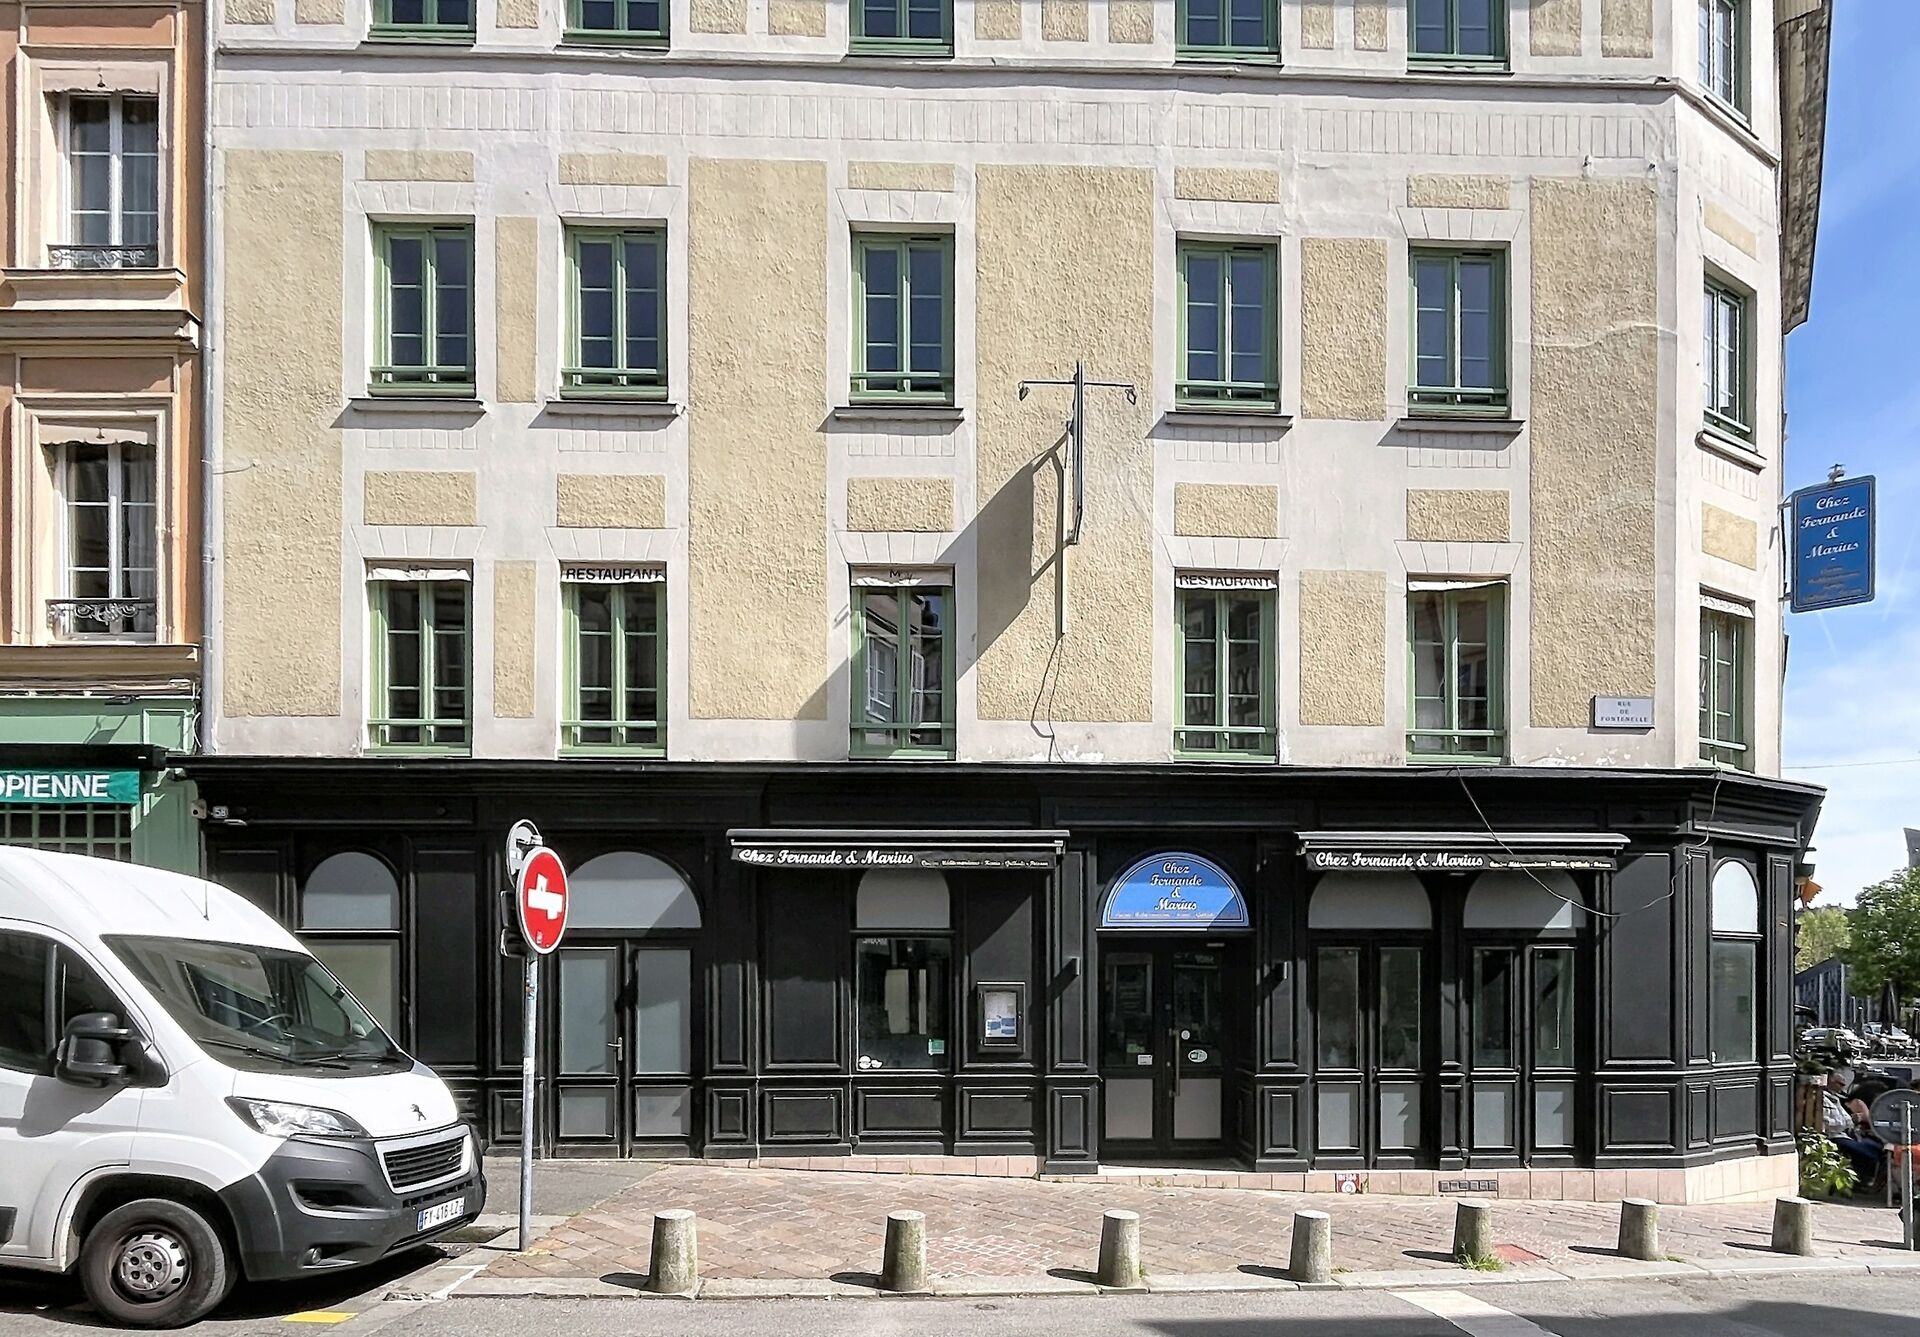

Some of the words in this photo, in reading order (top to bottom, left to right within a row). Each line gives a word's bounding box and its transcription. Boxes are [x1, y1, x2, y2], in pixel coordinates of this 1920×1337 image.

[1816, 496, 1850, 510] Chez
[1800, 507, 1866, 529] Fernande
[1826, 525, 1839, 539] &
[1805, 542, 1859, 559] Marius
[566, 568, 663, 580] RESTAURANT
[1180, 574, 1272, 587] RESTAURANT
[738, 849, 775, 864] Chez
[777, 849, 843, 865] Fernande
[845, 850, 858, 864] &
[861, 849, 914, 864] Marius
[1315, 851, 1349, 866] Chez
[1351, 852, 1414, 867] Fernande
[1416, 853, 1430, 867] &
[1431, 852, 1484, 866] Marius
[1162, 862, 1190, 874] Chez
[1150, 874, 1203, 886] Fernande
[1171, 887, 1181, 898] &
[1154, 897, 1197, 910] Marius
